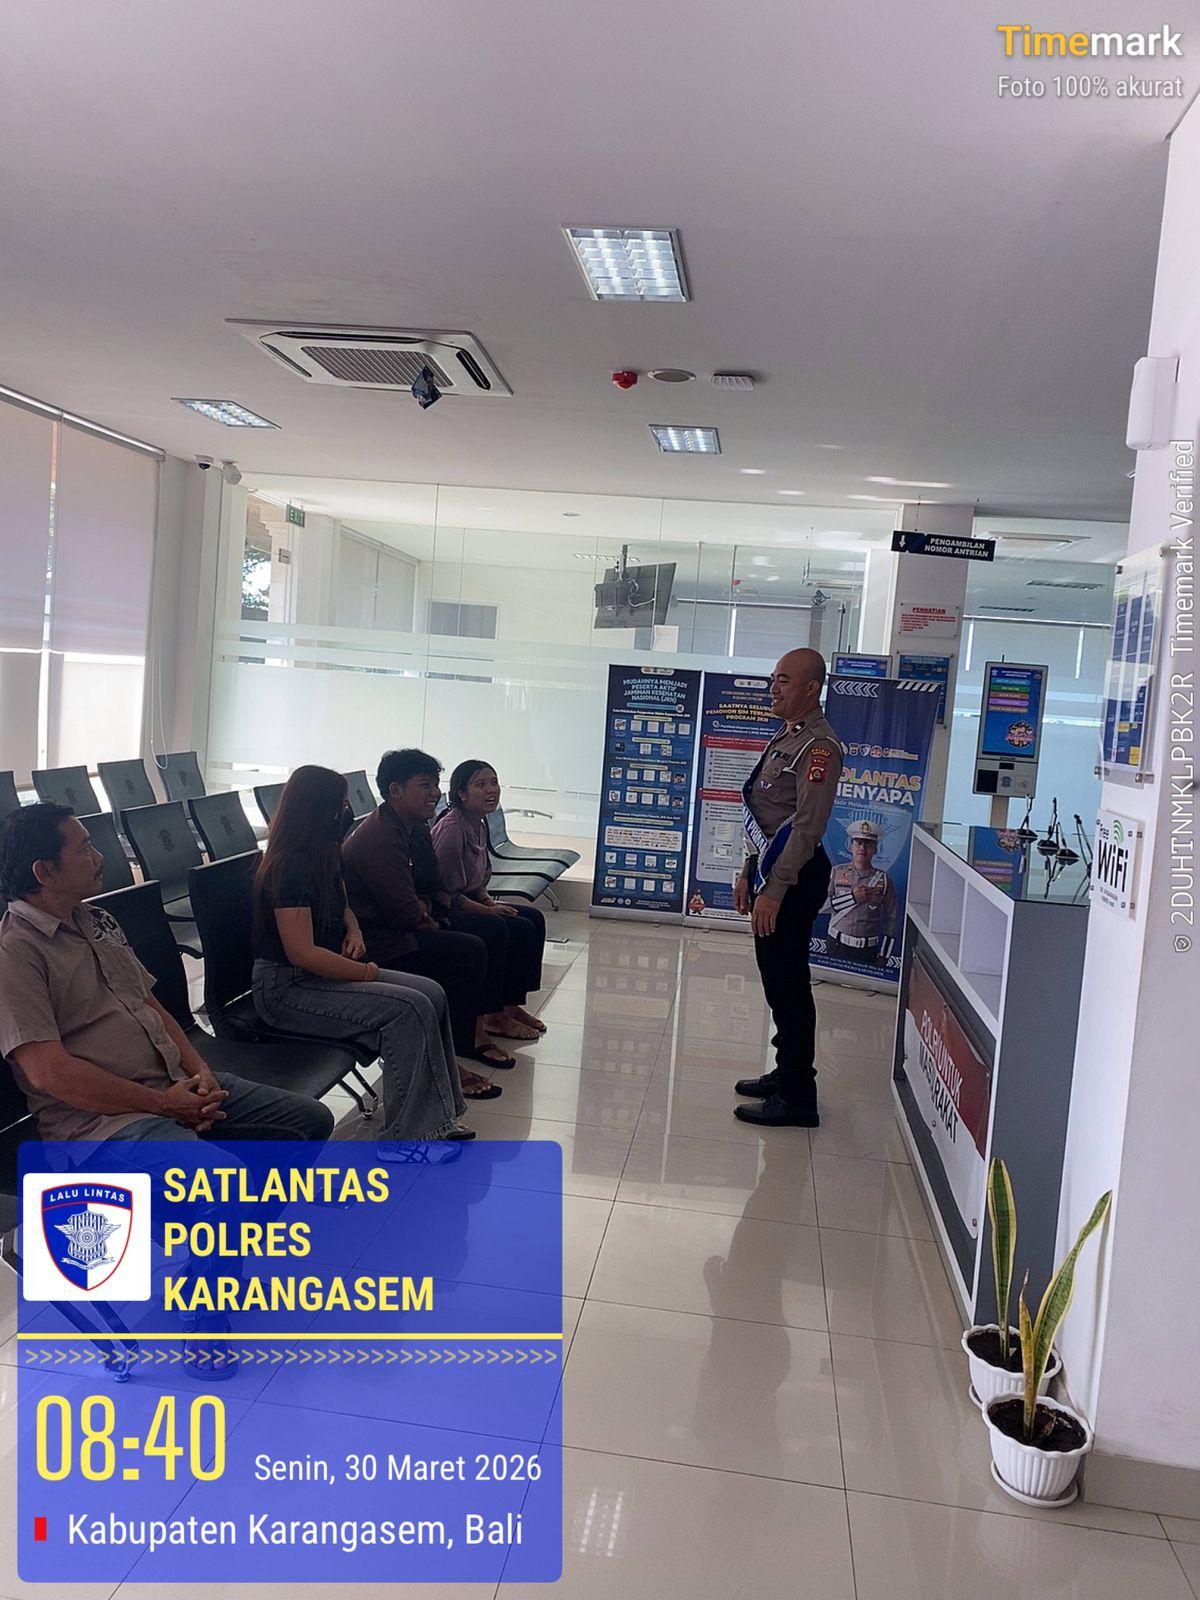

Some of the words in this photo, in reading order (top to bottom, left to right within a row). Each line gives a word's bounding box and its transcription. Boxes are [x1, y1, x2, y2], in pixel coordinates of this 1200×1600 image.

[930, 538, 985, 549] PENGAMBILAN
[924, 545, 953, 554] NOMOR
[954, 549, 988, 557] ANTRIAN
[912, 607, 946, 615] PERHATIAN
[839, 767, 922, 791] OLANTAS
[1098, 839, 1128, 893] WiFi
